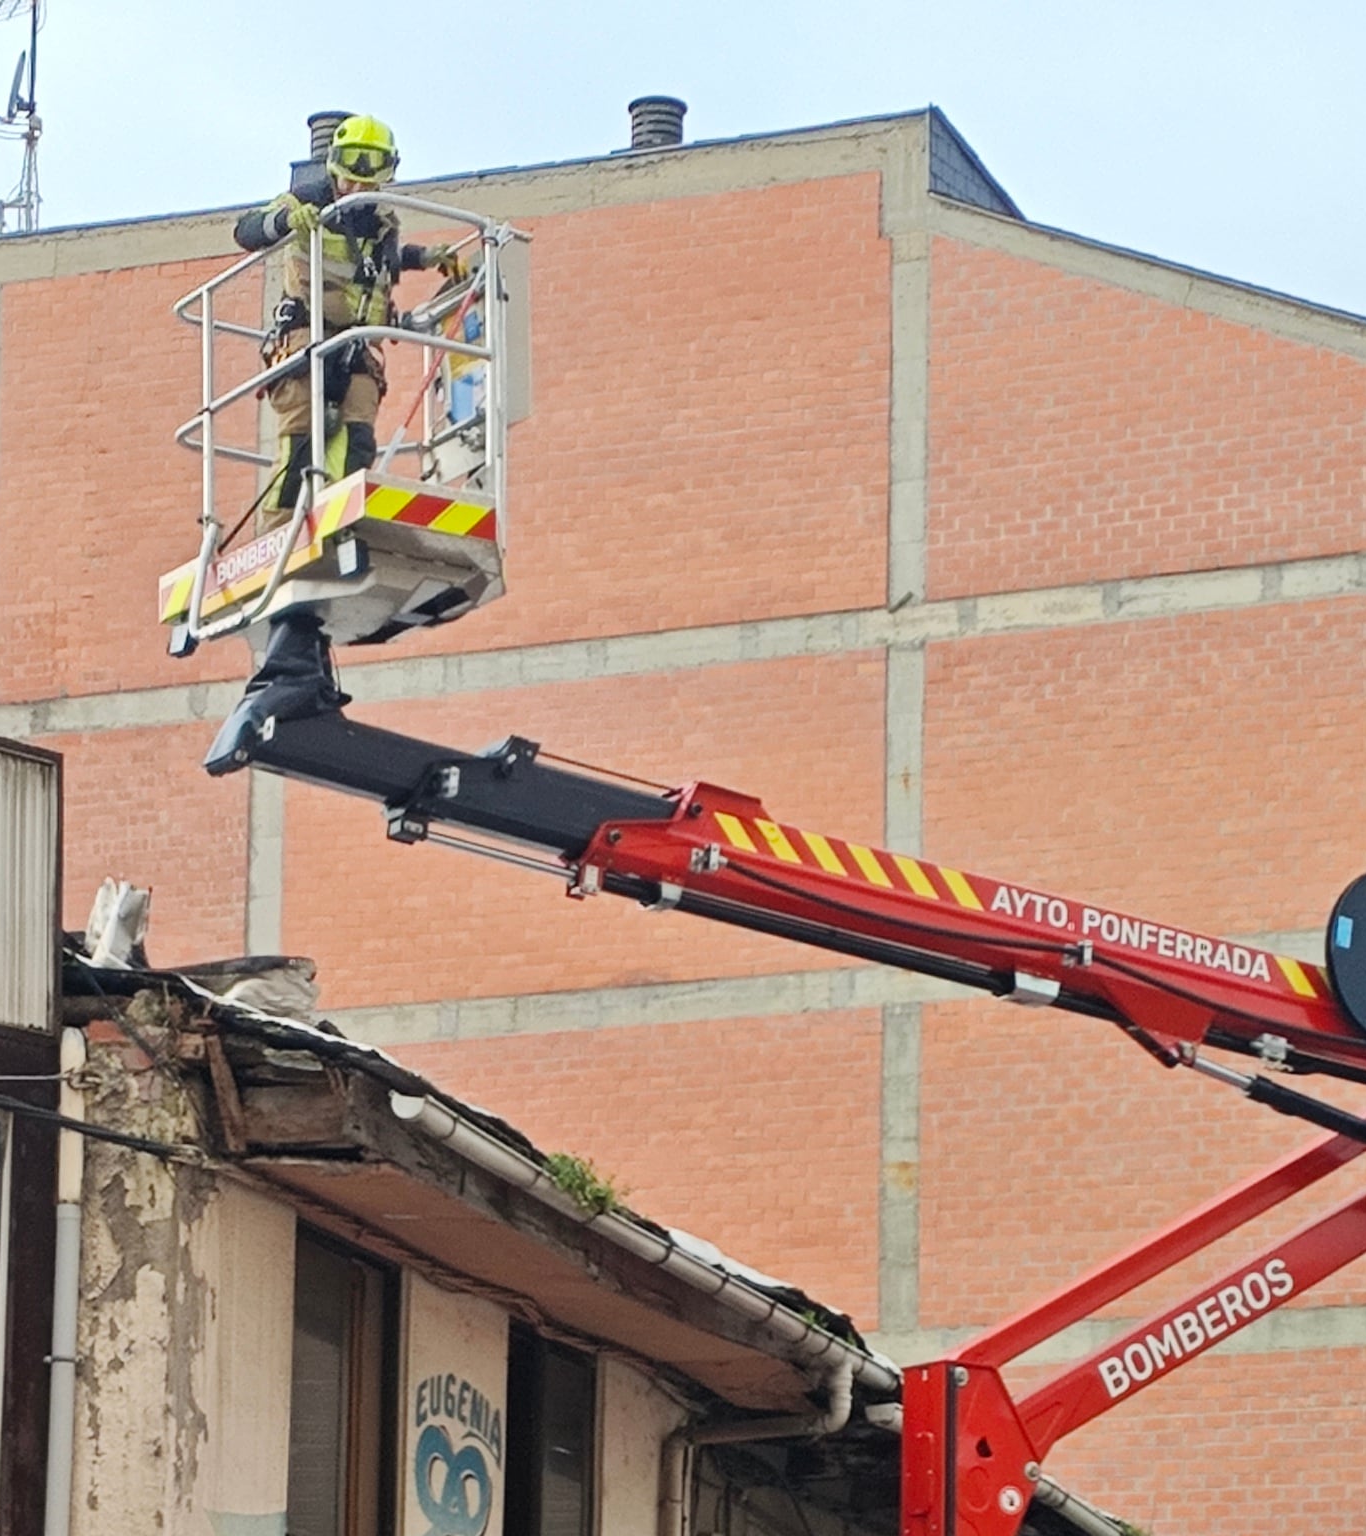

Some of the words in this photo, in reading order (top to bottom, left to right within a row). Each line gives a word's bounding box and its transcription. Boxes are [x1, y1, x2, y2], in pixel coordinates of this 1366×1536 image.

[216, 527, 292, 586] BOMBERO
[990, 886, 1076, 931] AYTO.
[1082, 907, 1271, 983] PONFERRADA
[1097, 1258, 1295, 1399] BOMBEROS
[414, 1373, 503, 1447] EUGENIA
